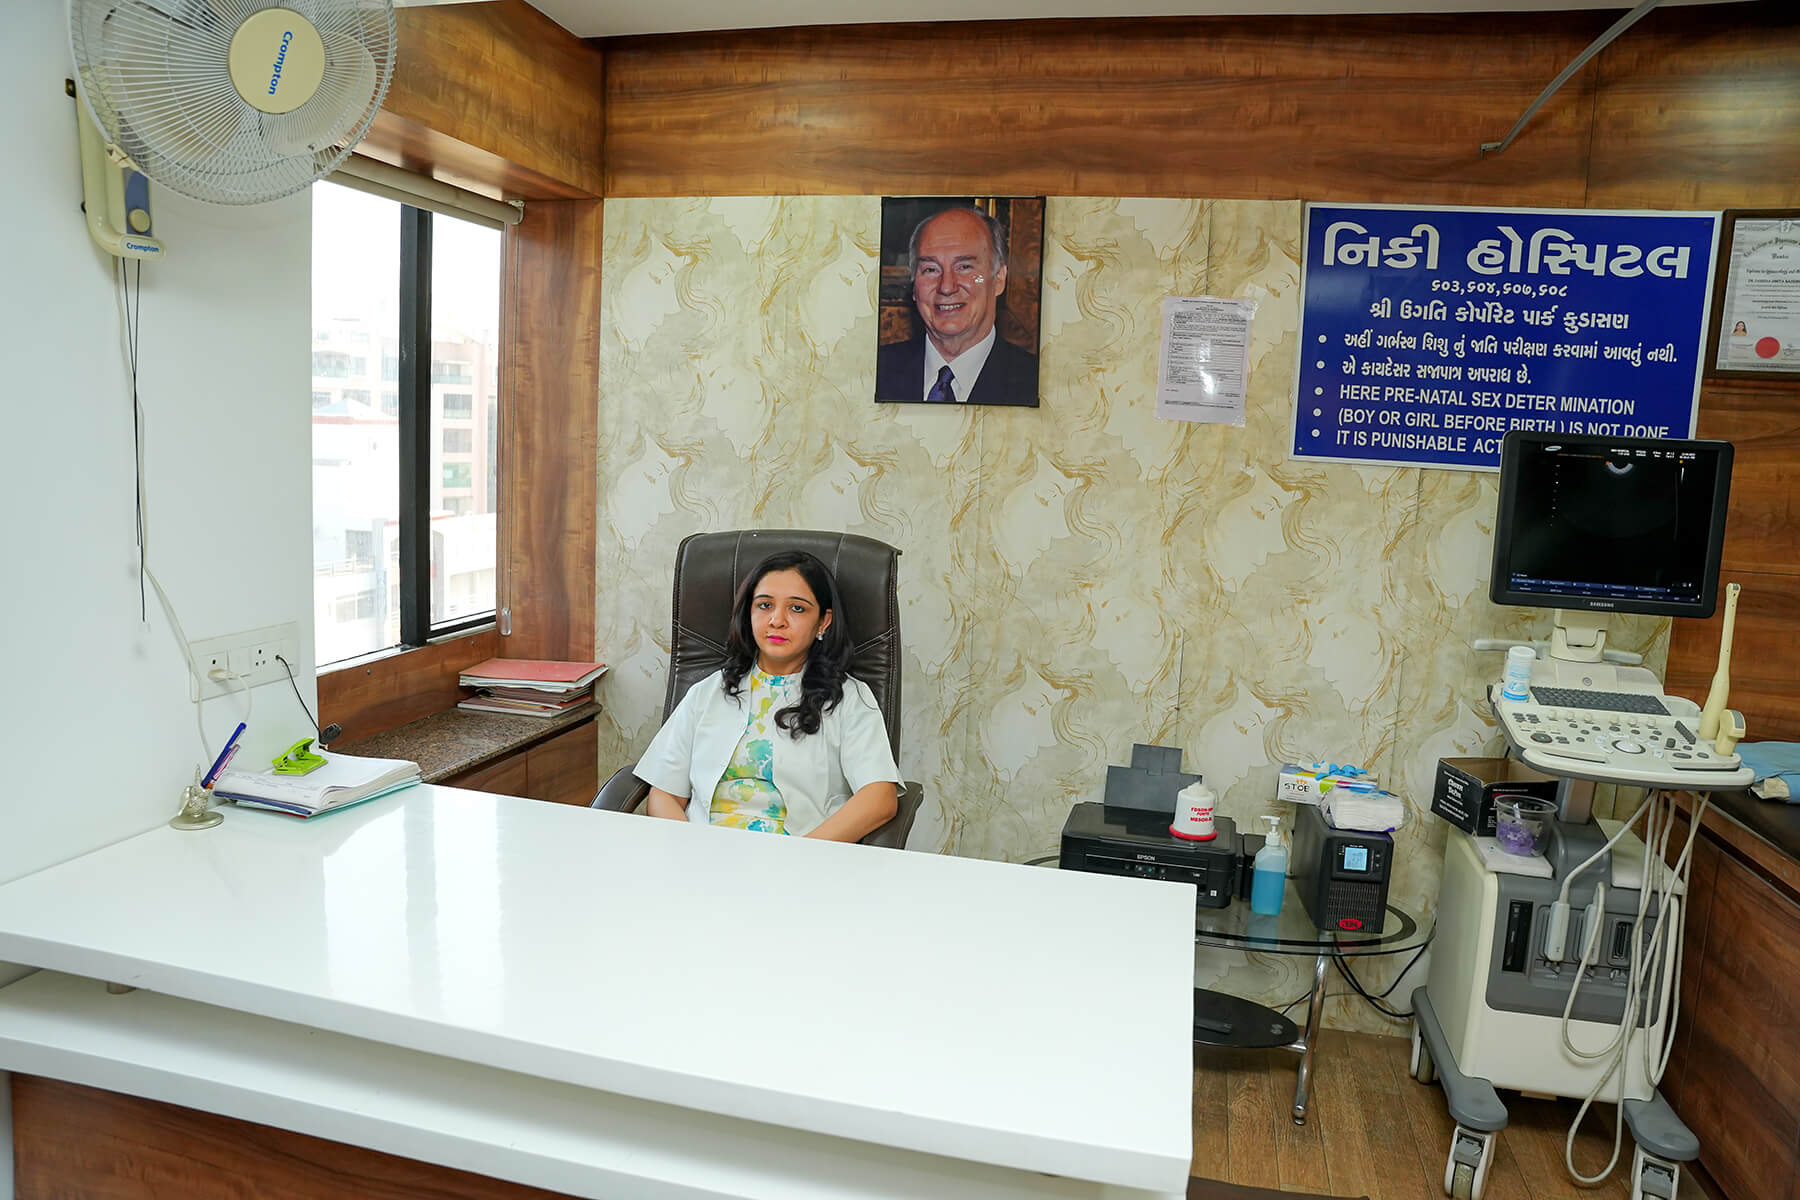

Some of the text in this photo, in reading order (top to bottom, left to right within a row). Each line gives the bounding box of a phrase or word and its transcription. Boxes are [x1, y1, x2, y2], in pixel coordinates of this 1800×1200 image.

[268, 31, 293, 95] Crompton
[126, 242, 159, 253] Crompton
[1323, 221, 1440, 270] નિકી
[1466, 225, 1691, 279] હોસ્પિટલ
[1369, 297, 1392, 319] શ્રી
[1522, 304, 1559, 326] પાર્ક
[1563, 311, 1629, 334] કુડાસણ
[1343, 328, 1374, 349] અહીં
[1375, 330, 1417, 350] ગર્ભસ્થ
[1421, 331, 1449, 358] શિશુ
[1470, 334, 1498, 354] જાતિ
[1502, 336, 1548, 358] પરીક્ષણ
[1552, 340, 1599, 359] કરવામાં
[1603, 342, 1642, 368] આવતું
[1646, 342, 1678, 363] નથી.
[1341, 354, 1356, 375] એ
[1360, 356, 1411, 378] કાયદેસર
[1467, 367, 1512, 384] અપરાધ
[1516, 363, 1532, 385] છે.
[1339, 383, 1635, 416] HERE PRE-NATAL SEX DETER MINATION
[1338, 407, 1376, 427] (BOY
[1378, 410, 1401, 426] OR
[1404, 411, 1440, 428] GIRL
[1444, 414, 1506, 431] BEFORE
[1568, 421, 1584, 434] IS
[1587, 422, 1621, 436] NOT
[1336, 429, 1351, 445] IT
[1353, 430, 1368, 446] IS
[1370, 431, 1467, 452] PUNISHABLE
